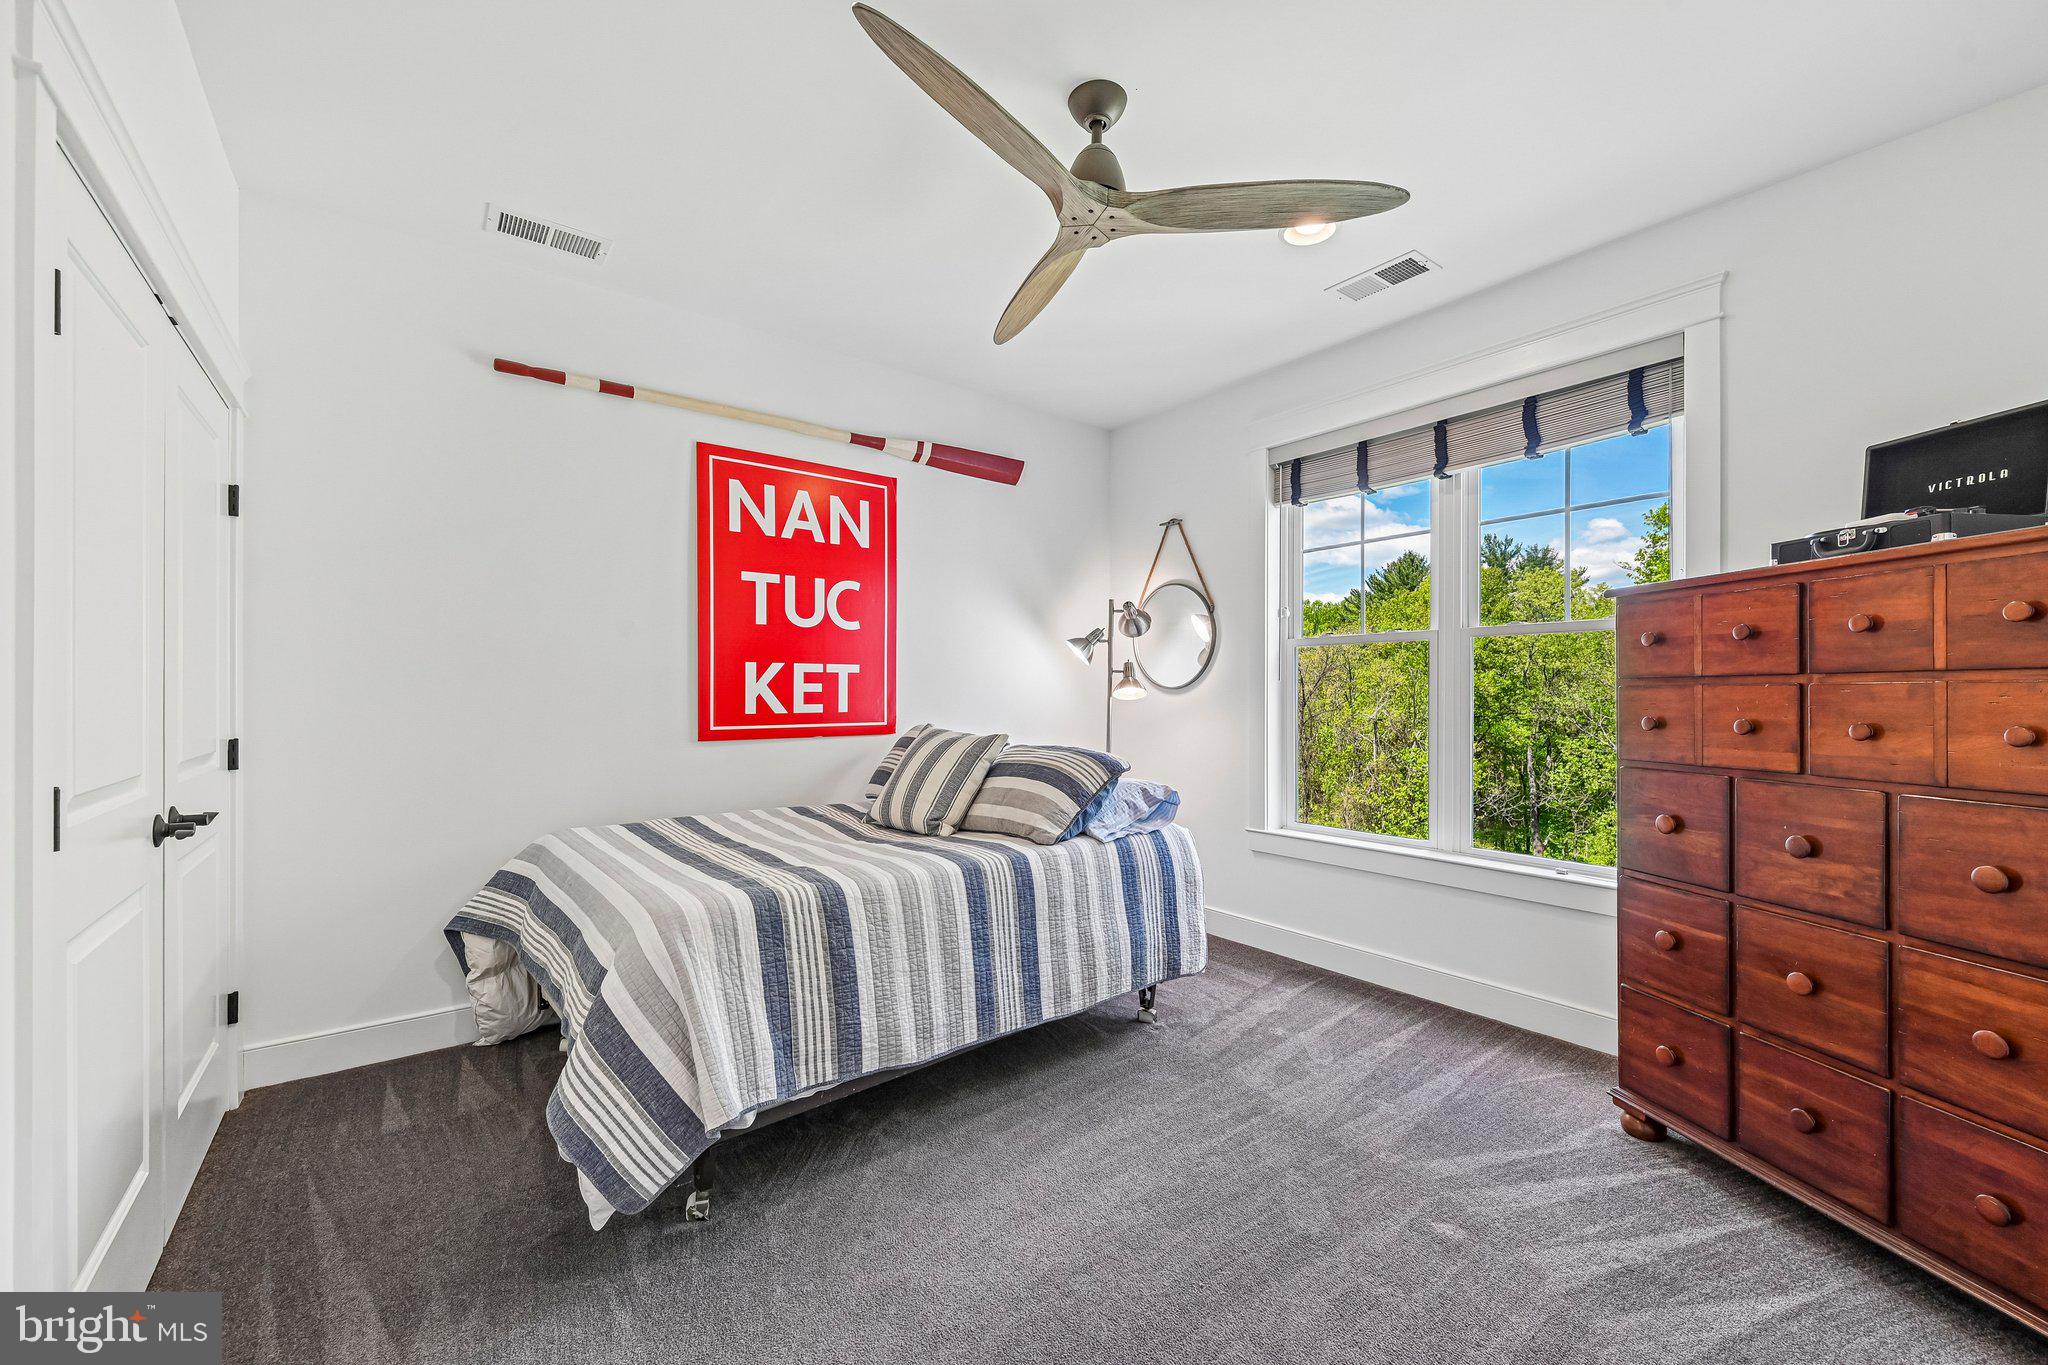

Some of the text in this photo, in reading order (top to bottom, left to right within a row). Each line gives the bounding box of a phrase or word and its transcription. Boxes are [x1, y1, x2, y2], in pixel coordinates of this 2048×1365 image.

[1927, 468, 2010, 494] VICTROLA
[728, 478, 870, 549] NAN
[740, 571, 861, 631] TUC
[744, 661, 861, 715] KET
